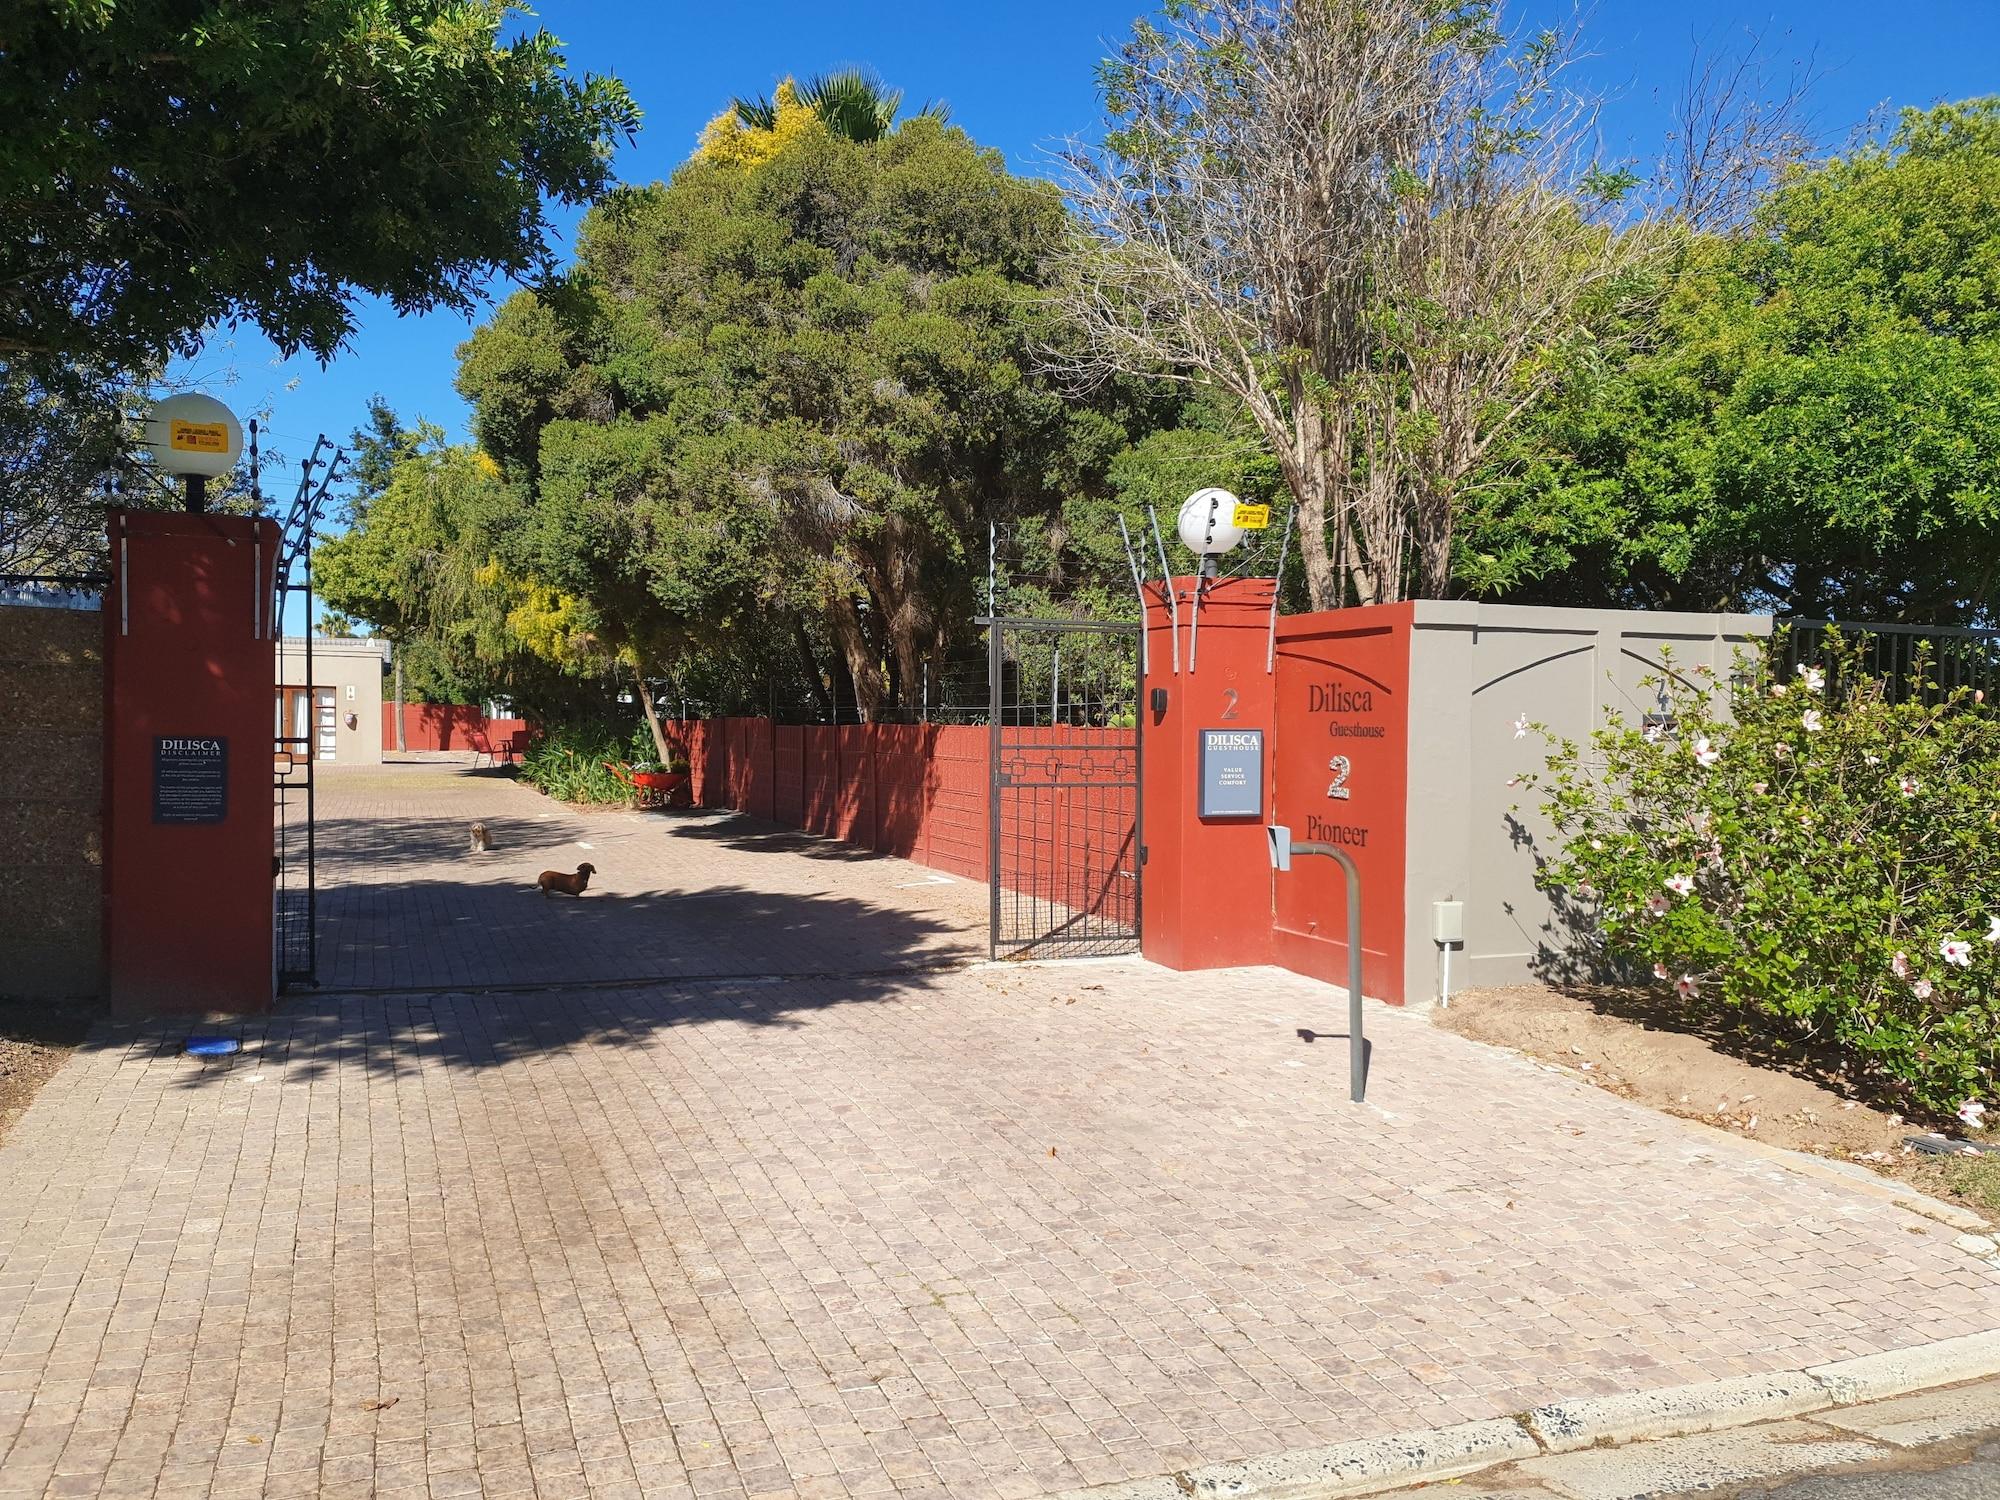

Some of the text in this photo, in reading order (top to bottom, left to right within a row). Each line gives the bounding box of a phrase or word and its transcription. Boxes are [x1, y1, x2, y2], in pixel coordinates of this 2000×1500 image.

[1220, 687, 1239, 719] 2
[1308, 683, 1373, 713] Dilisca
[1208, 734, 1259, 746] DILISCA
[1329, 720, 1385, 738] Guesthouse
[162, 739, 221, 750] DILISCA
[1327, 755, 1350, 799] 2
[1307, 815, 1368, 847] Pioneer
